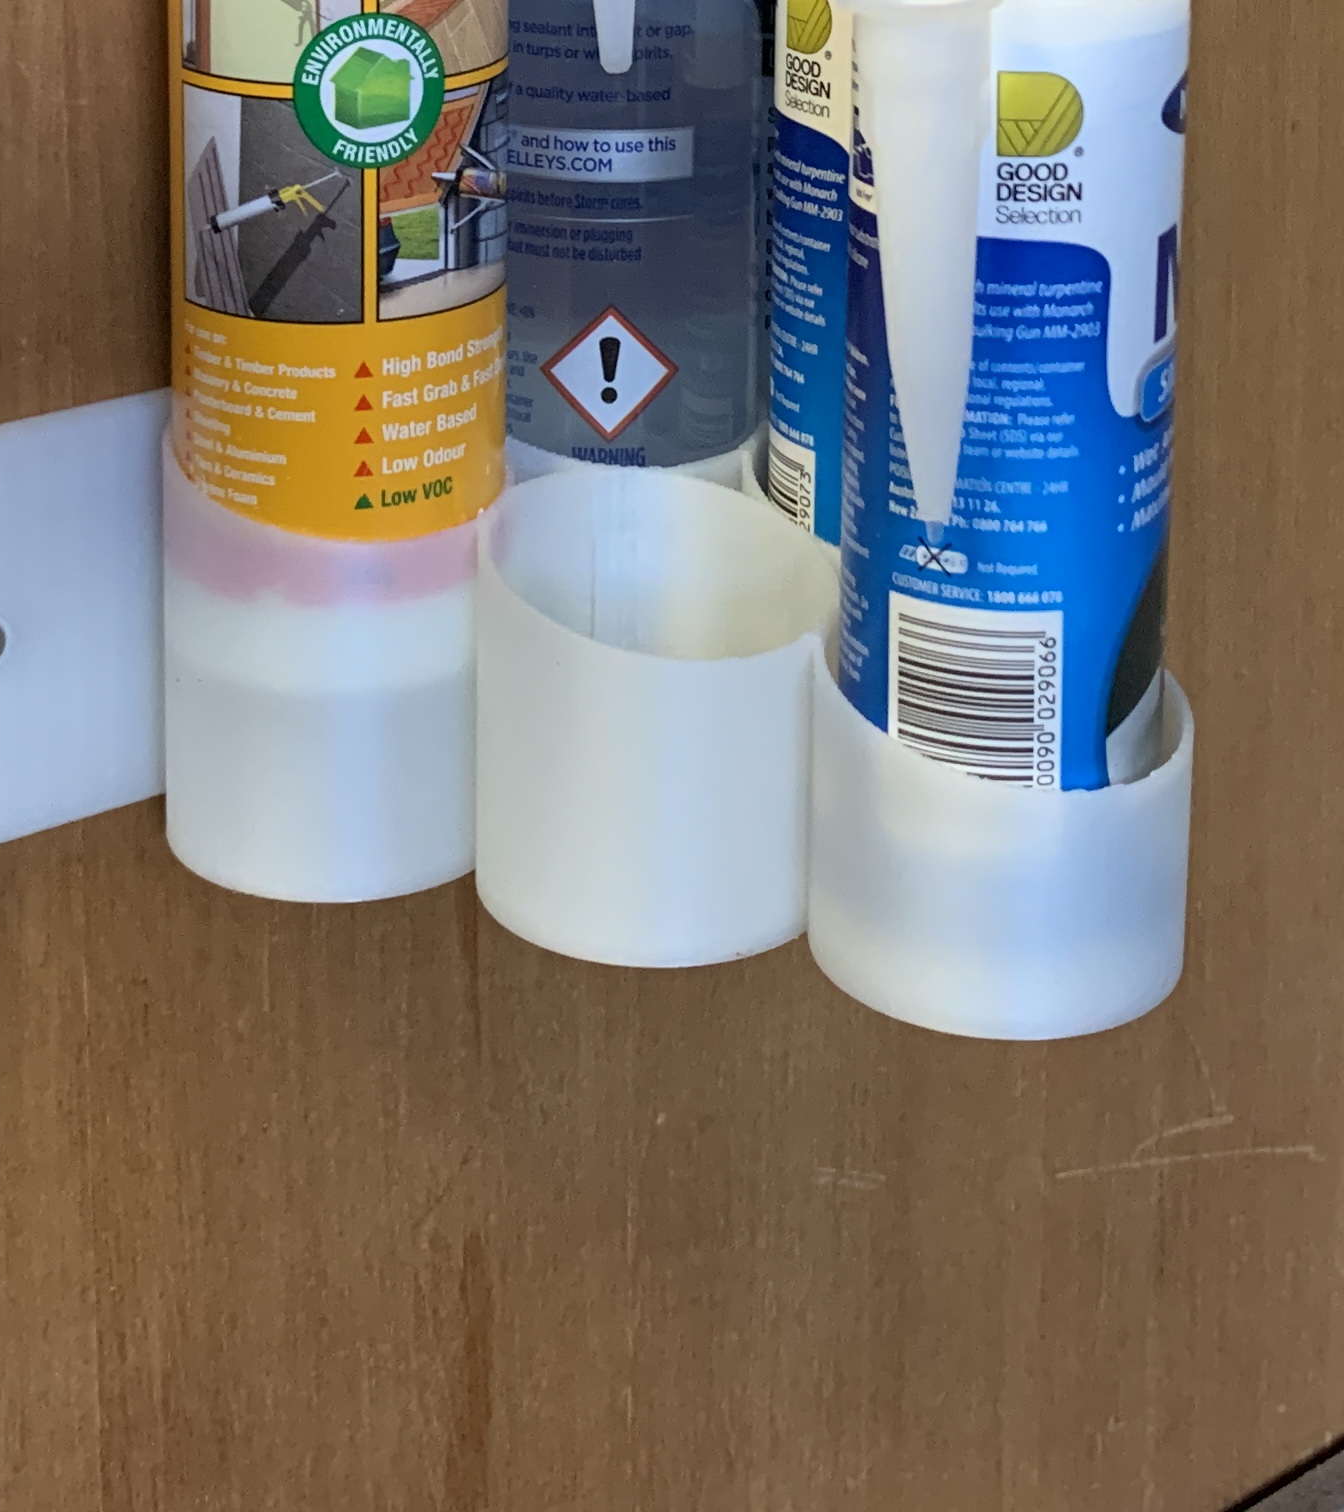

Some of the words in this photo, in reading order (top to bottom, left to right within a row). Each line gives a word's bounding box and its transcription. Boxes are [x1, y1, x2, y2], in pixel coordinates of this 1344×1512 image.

[523, 21, 573, 37] sealant
[646, 25, 661, 37] or
[301, 18, 440, 86] ENVIRONMENTALLY
[527, 42, 562, 59] turps
[564, 48, 579, 60] or
[785, 53, 822, 78] GOOD
[526, 84, 575, 103] quality
[785, 71, 831, 100] DESIGN
[784, 90, 831, 119] Selection
[333, 127, 419, 163] FRIENDLY
[521, 135, 550, 150] and
[554, 135, 589, 153] how
[593, 138, 612, 153] to
[616, 139, 644, 154] use
[647, 135, 677, 153] this
[996, 162, 1069, 181] GOOD
[996, 183, 1082, 202] DESIGN
[995, 206, 1082, 224] Selection
[235, 357, 275, 376] Timber
[278, 363, 337, 379] Products
[382, 355, 422, 378] High
[427, 343, 464, 370] Bond
[382, 388, 419, 409] Fast
[423, 379, 458, 403] Grab
[460, 374, 471, 393] &
[267, 406, 317, 424] Cement
[382, 419, 433, 442] Water
[436, 402, 478, 433] Based
[382, 455, 419, 476] Low
[423, 441, 467, 469] Odour
[571, 446, 646, 468] WARNING
[381, 487, 418, 508] Low
[422, 475, 453, 500] VOC
